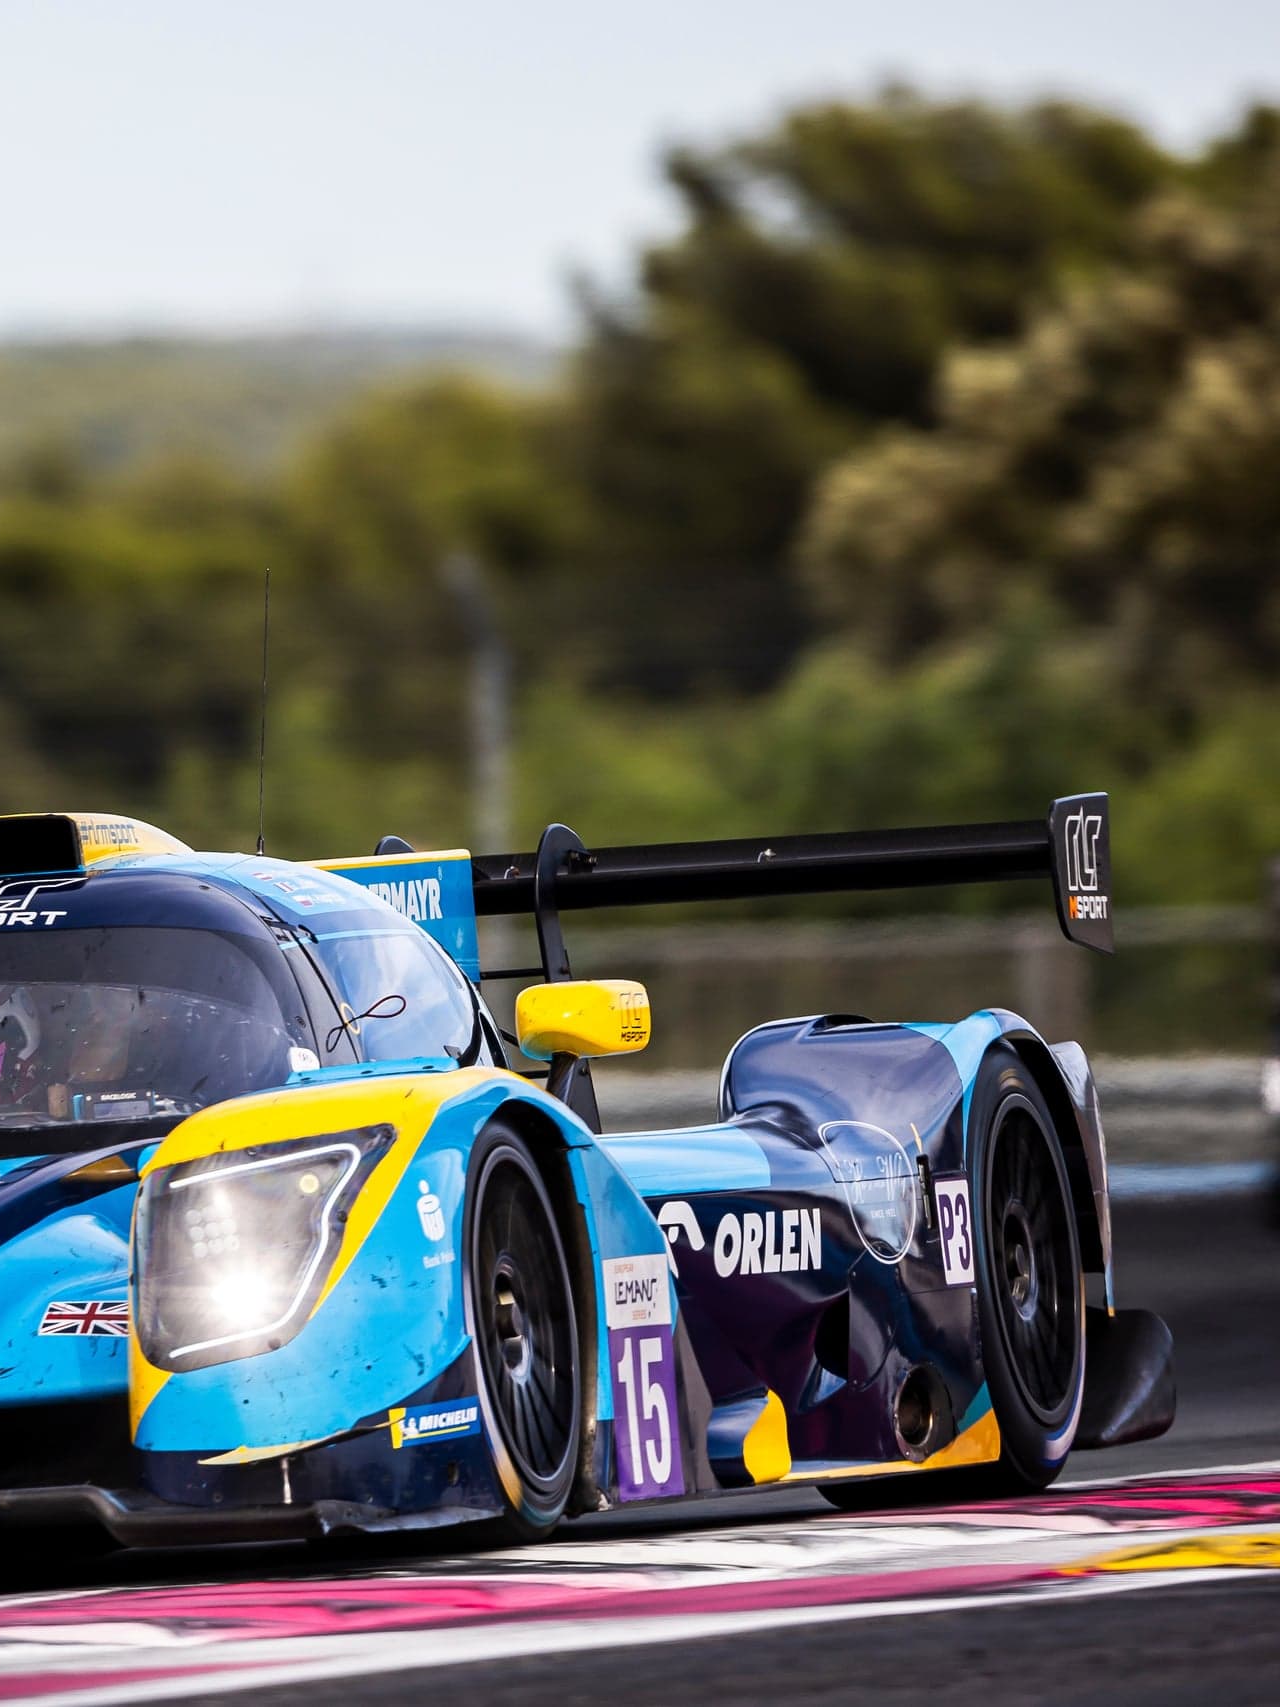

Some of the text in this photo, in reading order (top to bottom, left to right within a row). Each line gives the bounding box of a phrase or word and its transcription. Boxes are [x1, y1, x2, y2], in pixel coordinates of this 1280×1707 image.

[1069, 896, 1108, 919] MSPORT
[713, 1208, 822, 1278] ORLEN
[939, 1193, 971, 1272] P3
[419, 1406, 478, 1432] MICHELIN
[617, 1336, 672, 1486] 15
